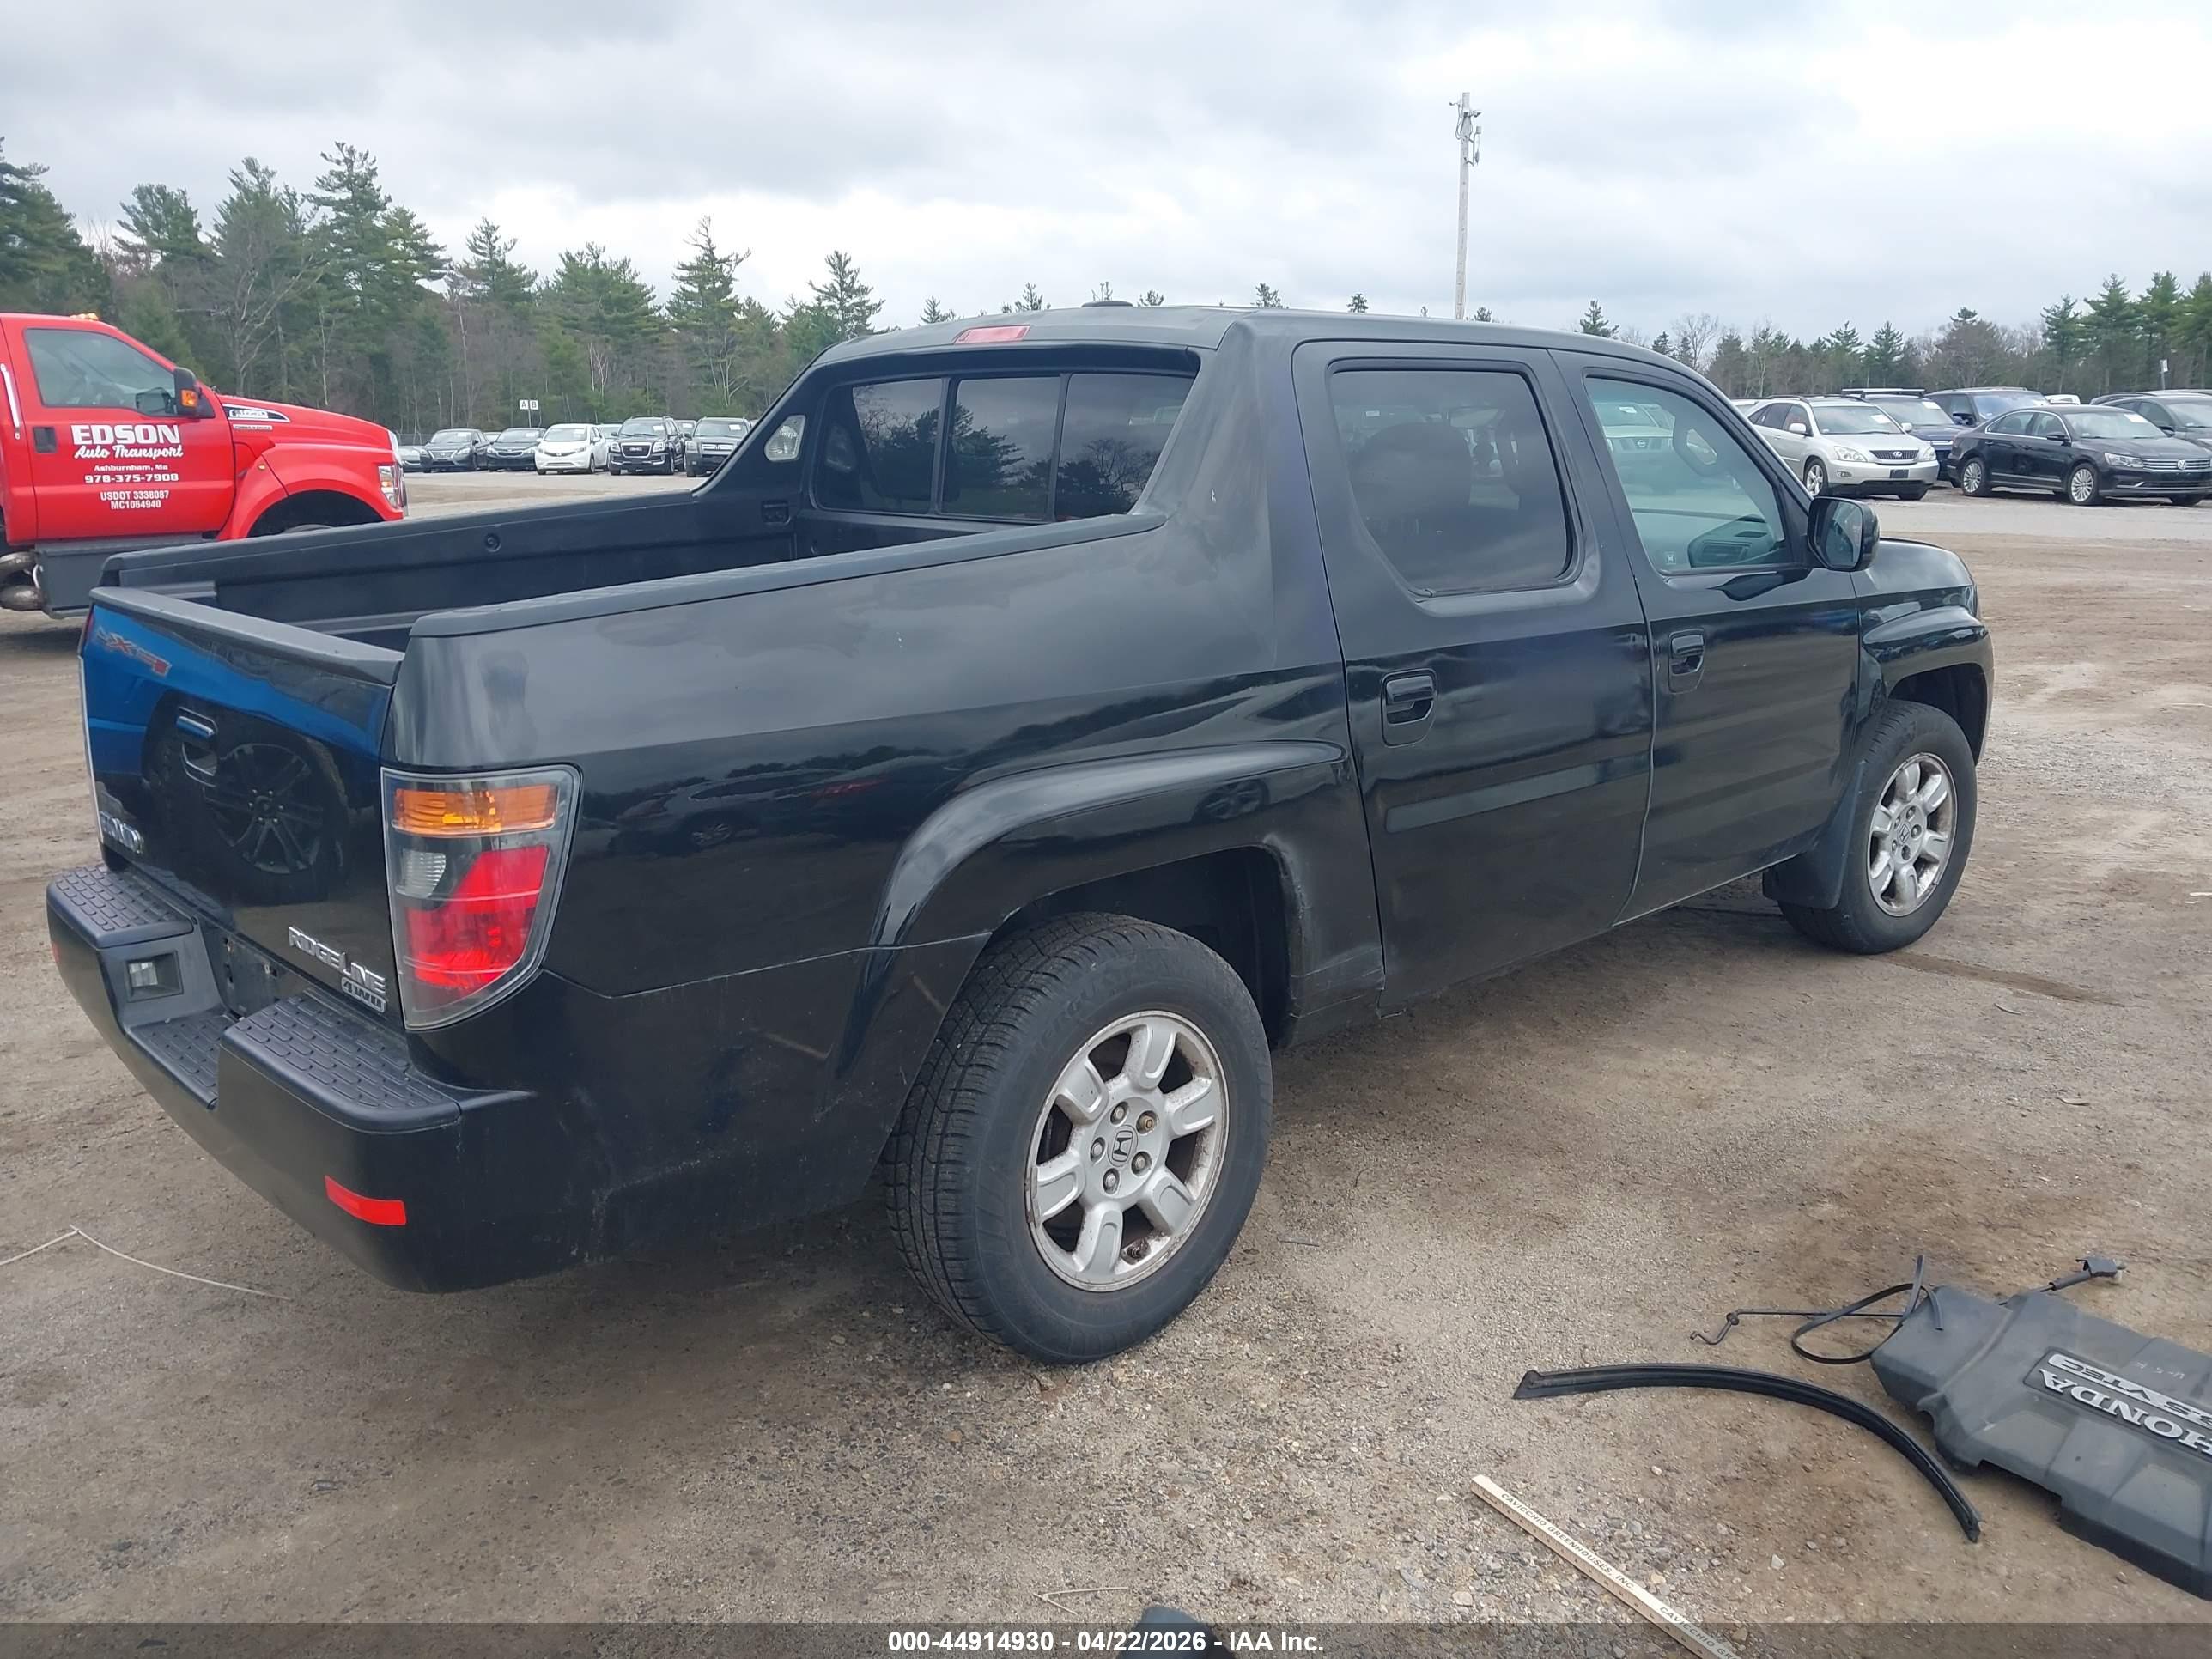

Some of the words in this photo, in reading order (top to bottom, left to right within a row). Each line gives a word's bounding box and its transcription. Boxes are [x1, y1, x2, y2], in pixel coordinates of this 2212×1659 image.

[71, 424, 180, 445] EDSON
[74, 445, 110, 459] Auto
[112, 444, 184, 460] Transport
[84, 473, 179, 483] 978-375-7908
[100, 490, 131, 501] USDOT
[133, 489, 169, 500] 3338087
[342, 979, 385, 1012] 4WD
[2060, 1358, 2151, 1402] VTEC
[2039, 1369, 2212, 1456] HONDA
[1501, 1493, 1547, 1526] CAVICCHIO
[1547, 1526, 1613, 1575] GREENHOUSES,
[1659, 1607, 1716, 1647] CAVICCHIO
